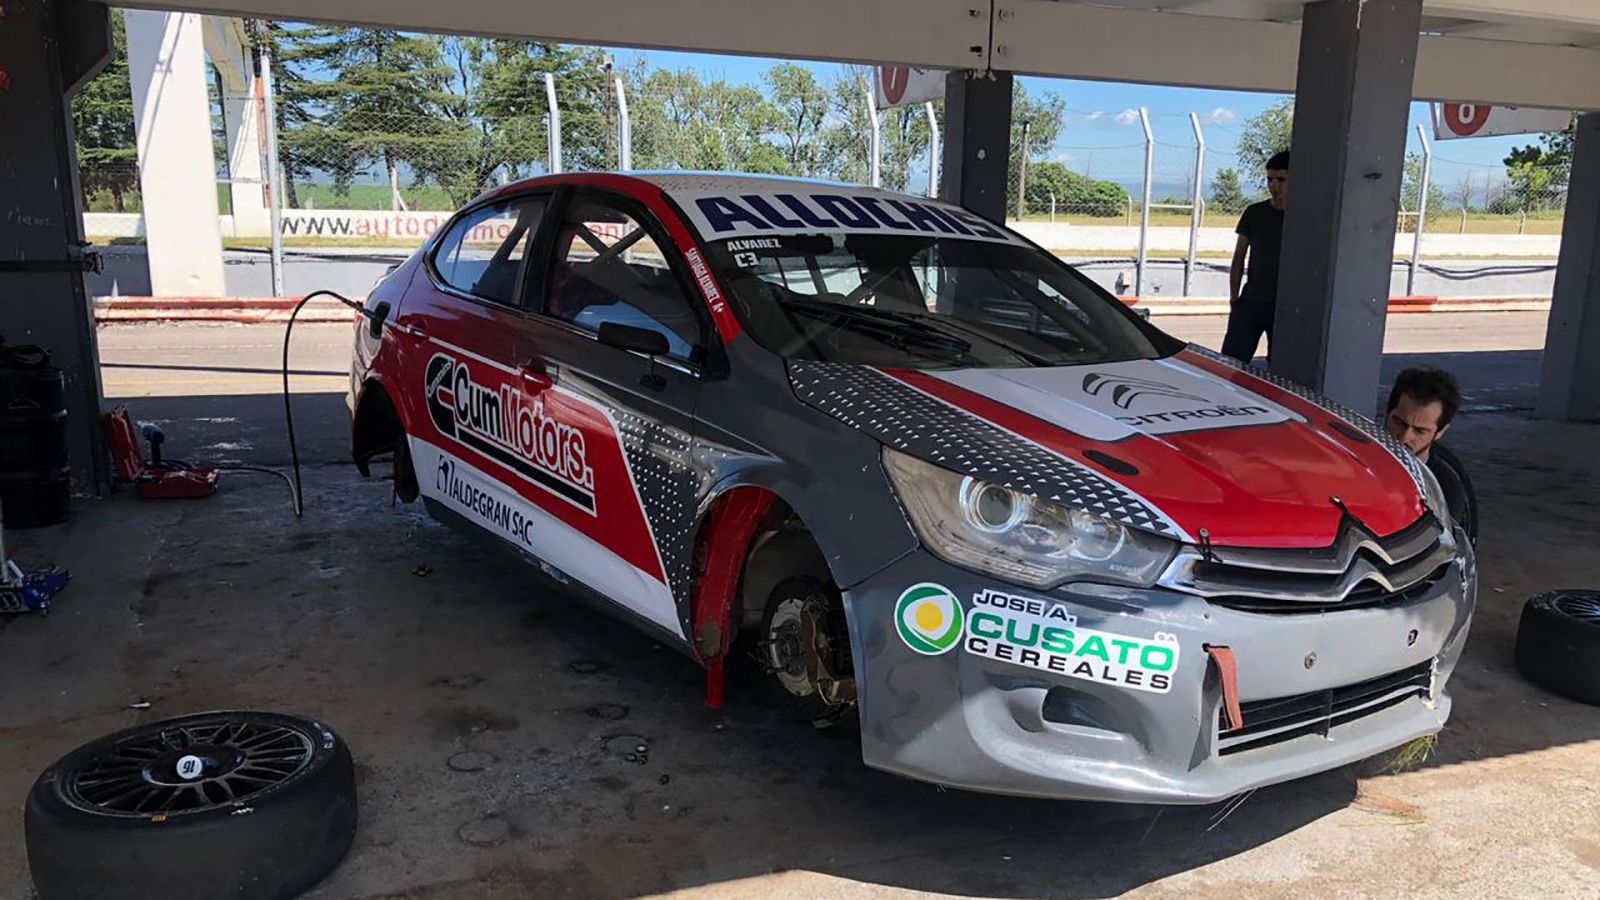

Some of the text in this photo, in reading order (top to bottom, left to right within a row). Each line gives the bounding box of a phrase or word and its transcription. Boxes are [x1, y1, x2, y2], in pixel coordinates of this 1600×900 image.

[695, 194, 1009, 240] ALLOCHIS
[727, 238, 782, 252] ALVAREZ
[734, 252, 760, 268] C3
[512, 511, 534, 546] SAC
[976, 592, 1075, 622] JOSE A.
[969, 612, 1174, 672] CUSATO
[968, 638, 1169, 690] CEREALES
